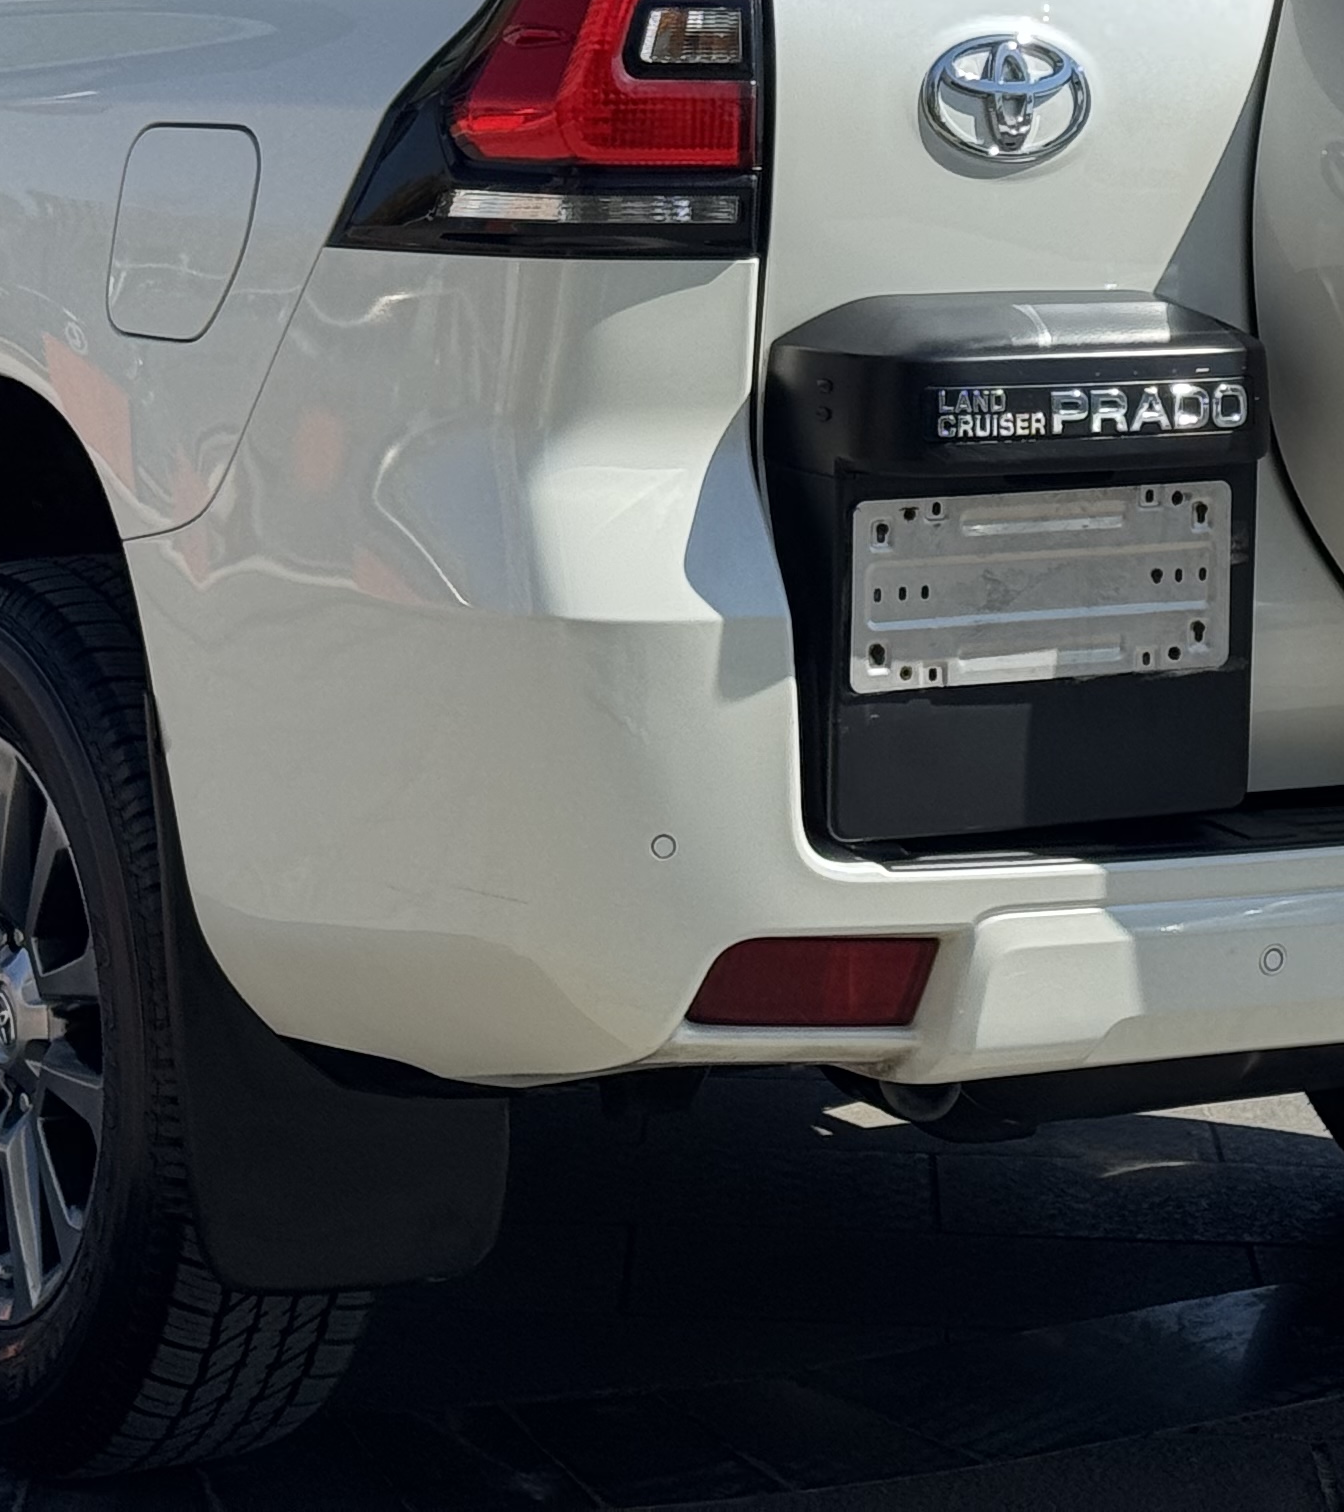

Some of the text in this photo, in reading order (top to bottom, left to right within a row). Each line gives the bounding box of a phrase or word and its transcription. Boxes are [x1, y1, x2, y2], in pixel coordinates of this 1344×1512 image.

[937, 389, 1007, 414] LAND
[1050, 383, 1249, 435] PRADO
[937, 412, 1047, 439] CRUISER
